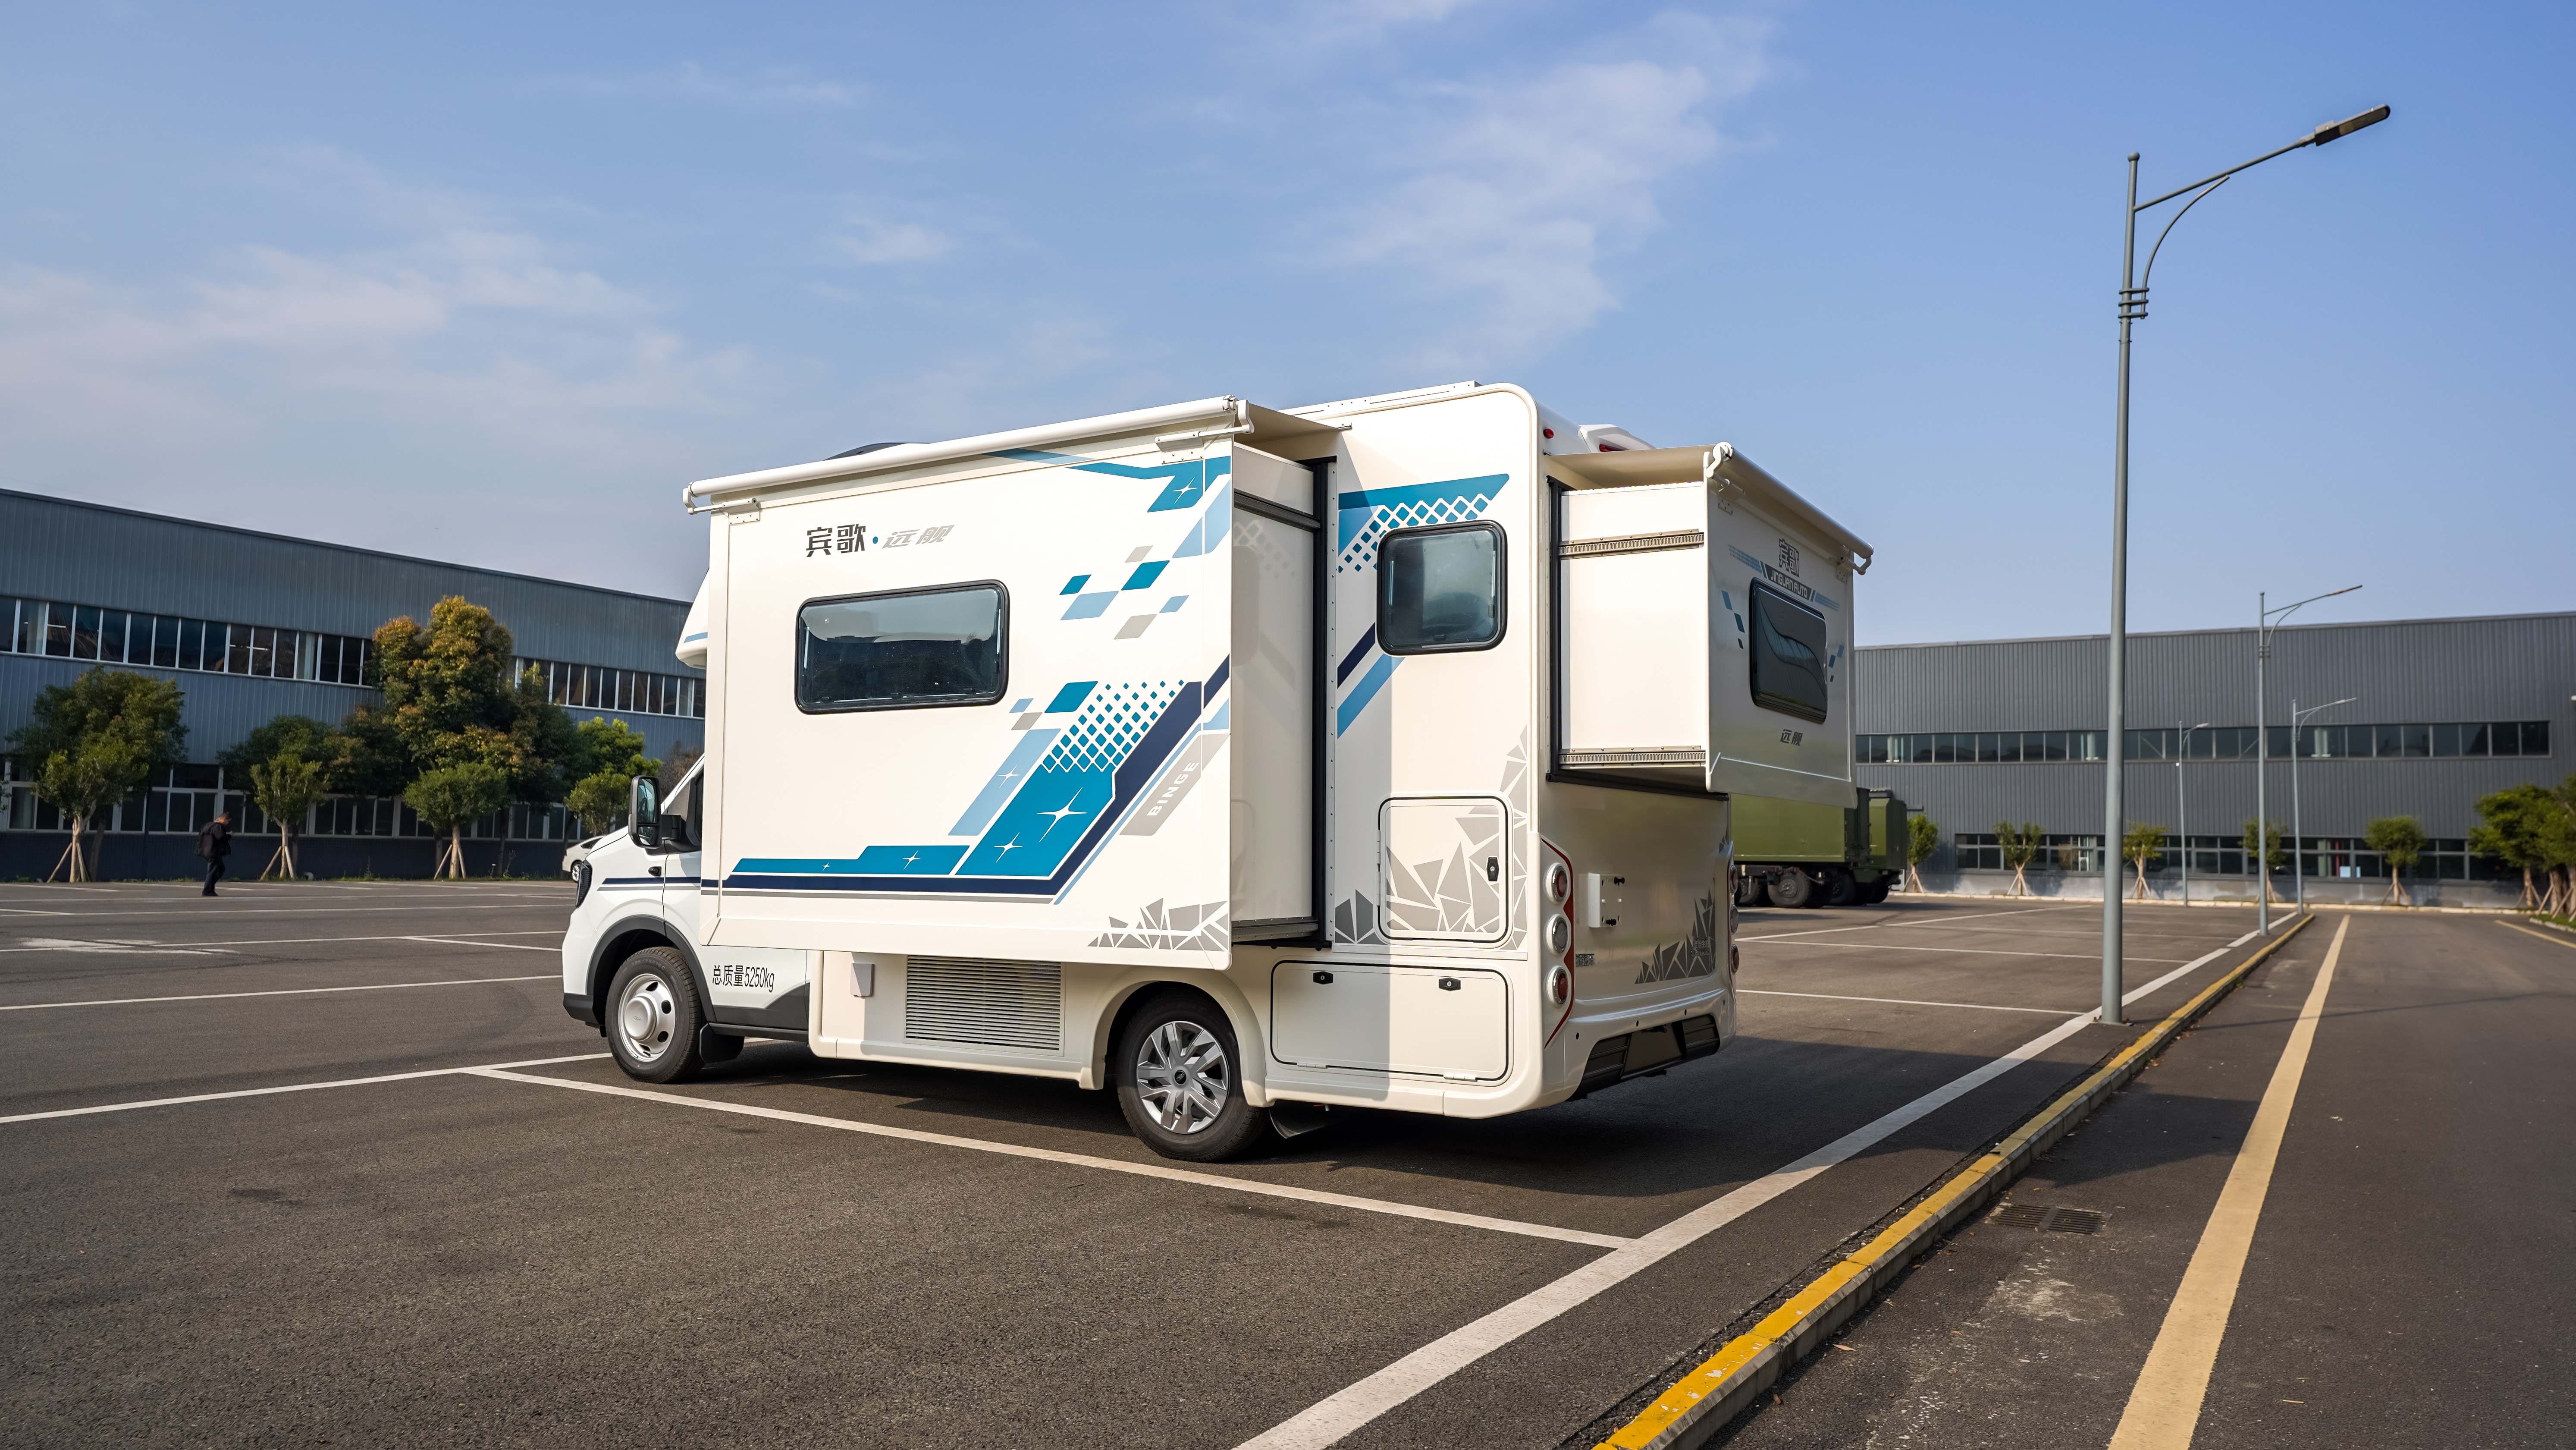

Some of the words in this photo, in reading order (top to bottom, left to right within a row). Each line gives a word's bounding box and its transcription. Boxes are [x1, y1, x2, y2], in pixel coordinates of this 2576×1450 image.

[1779, 538, 1799, 577] 宾歌
[1770, 570, 1793, 591] JINGUAN
[1794, 581, 1807, 598] AUTO
[1780, 729, 1803, 746] 远舰
[1146, 762, 1200, 816] BINGE
[712, 965, 774, 992] 总质量5250kg
